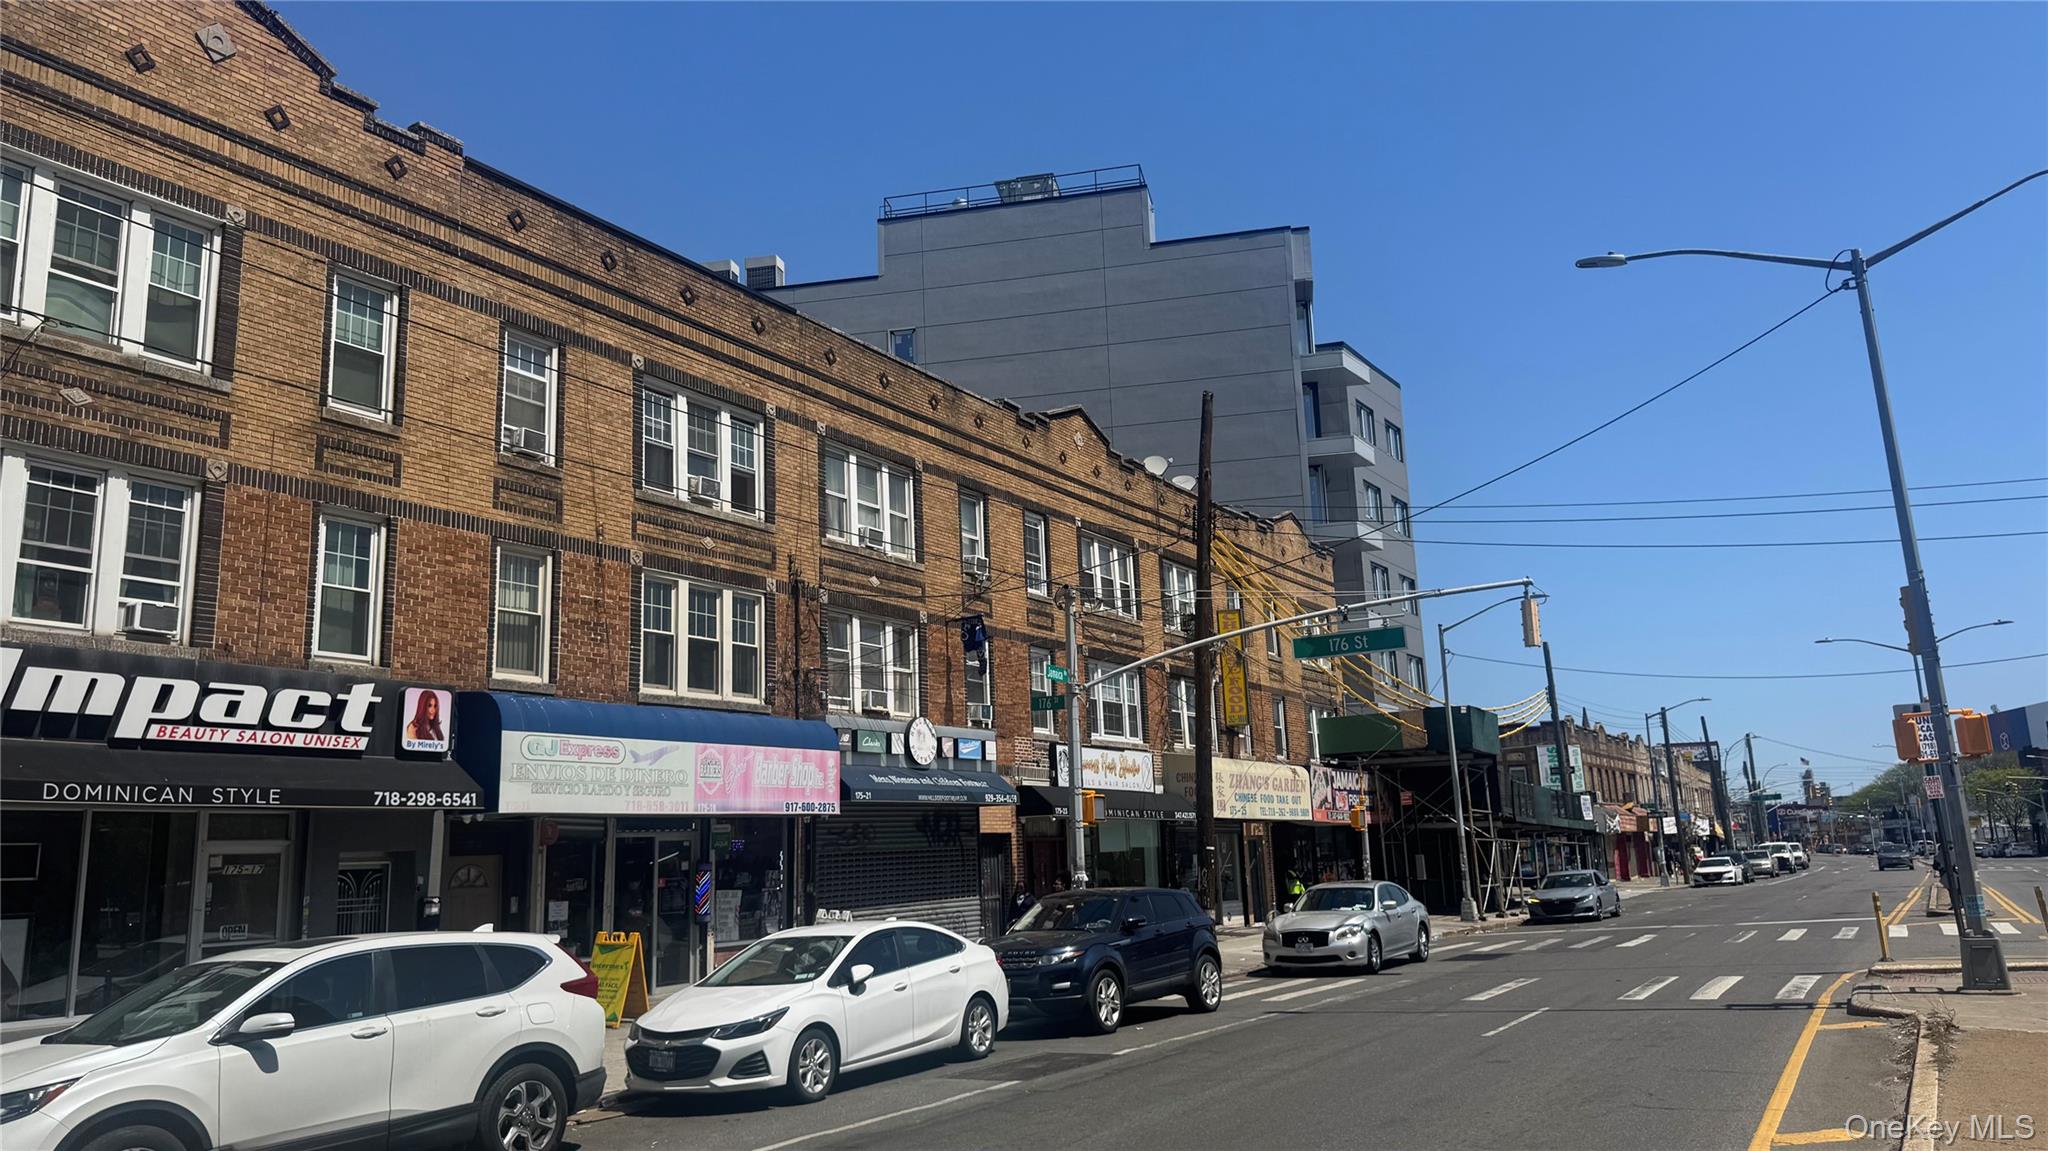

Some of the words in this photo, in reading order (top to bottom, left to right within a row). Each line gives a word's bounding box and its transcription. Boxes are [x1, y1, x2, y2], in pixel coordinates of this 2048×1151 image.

[1329, 638, 1349, 652] 176
[1354, 635, 1369, 649] St
[1039, 698, 1052, 709] 176
[156, 726, 229, 742] BEAUTY
[236, 730, 297, 745] SALON
[303, 735, 363, 749] UNISEX
[406, 741, 416, 749] By
[417, 741, 444, 750] Mirely's
[559, 739, 621, 760] Express
[511, 763, 587, 782] ENVIOS
[592, 766, 617, 782] DE
[620, 767, 689, 785] DINERO
[754, 752, 790, 785] Barber
[791, 755, 816, 795] Shop
[531, 782, 581, 795] SERVICIO
[1229, 773, 1270, 791] ZHANG'S
[1272, 777, 1307, 792] GARDEN
[43, 782, 193, 804] DOMINICAN
[212, 788, 281, 805] STYLE
[374, 791, 477, 806] 718-298-6541
[855, 791, 872, 800] 175-21
[1234, 792, 1258, 803] CHINESE
[1260, 794, 1275, 803] FOOD
[1276, 795, 1289, 805] TAKE
[1291, 796, 1302, 805] OUT
[785, 802, 836, 813] 917-600-2875
[1105, 809, 1140, 818] MINICAN
[1143, 811, 1164, 819] STYLE
[221, 924, 246, 937] OPEN
